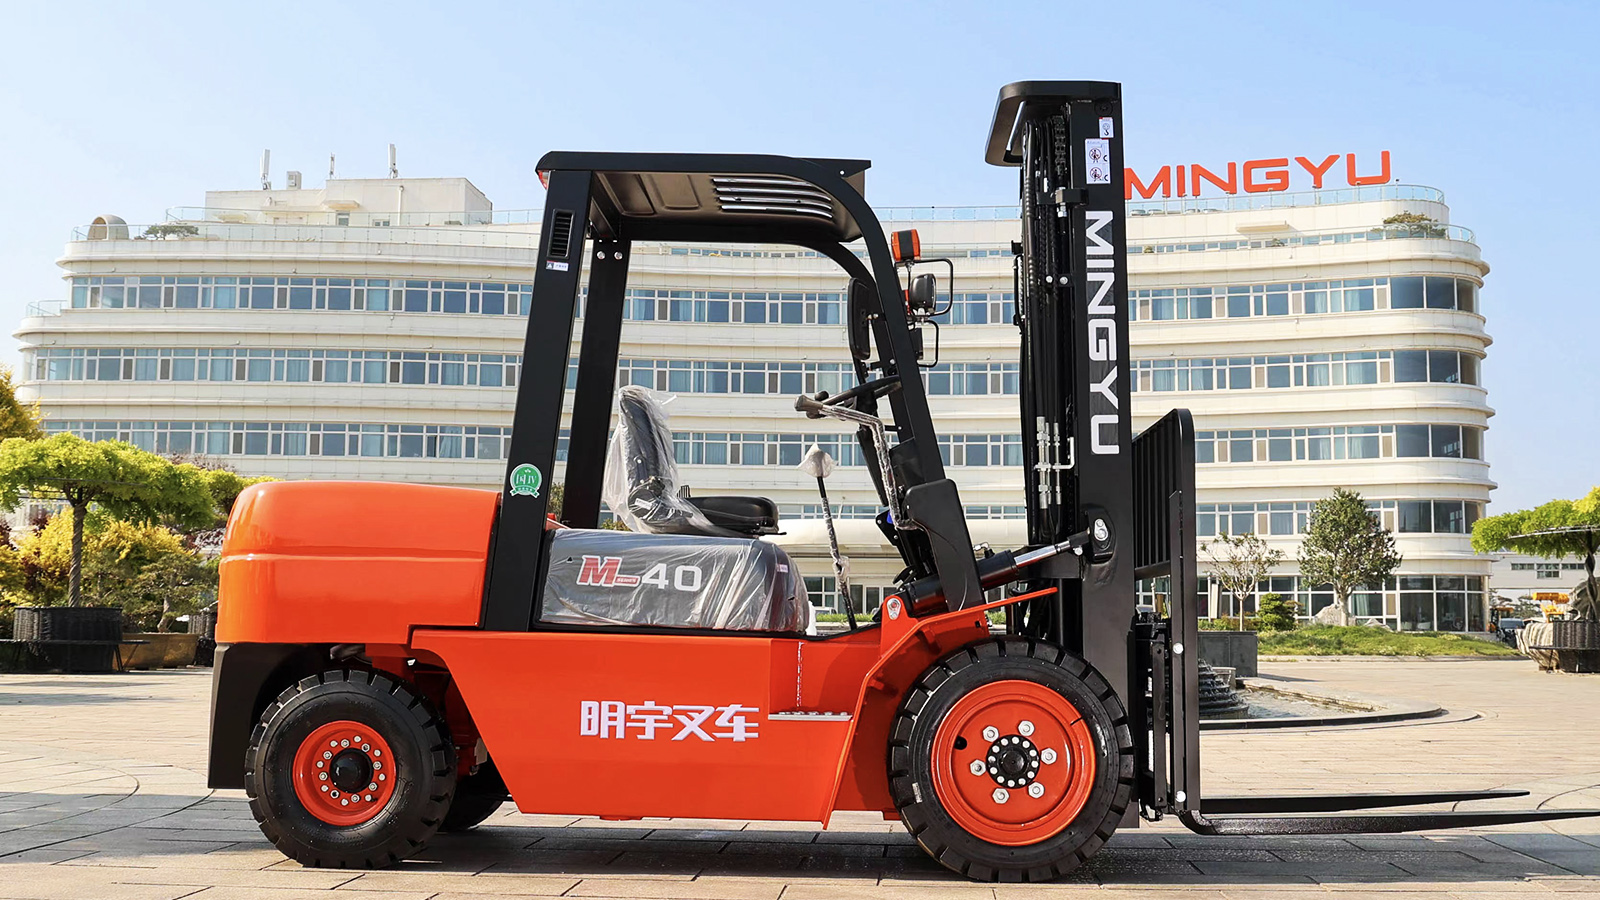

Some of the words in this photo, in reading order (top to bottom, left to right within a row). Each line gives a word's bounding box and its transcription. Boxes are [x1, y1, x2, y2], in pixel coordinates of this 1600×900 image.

[1124, 151, 1390, 199] MINGYU
[1085, 211, 1119, 454] MINGYU
[641, 562, 702, 592] 40
[580, 701, 760, 742] 明宇叉车
